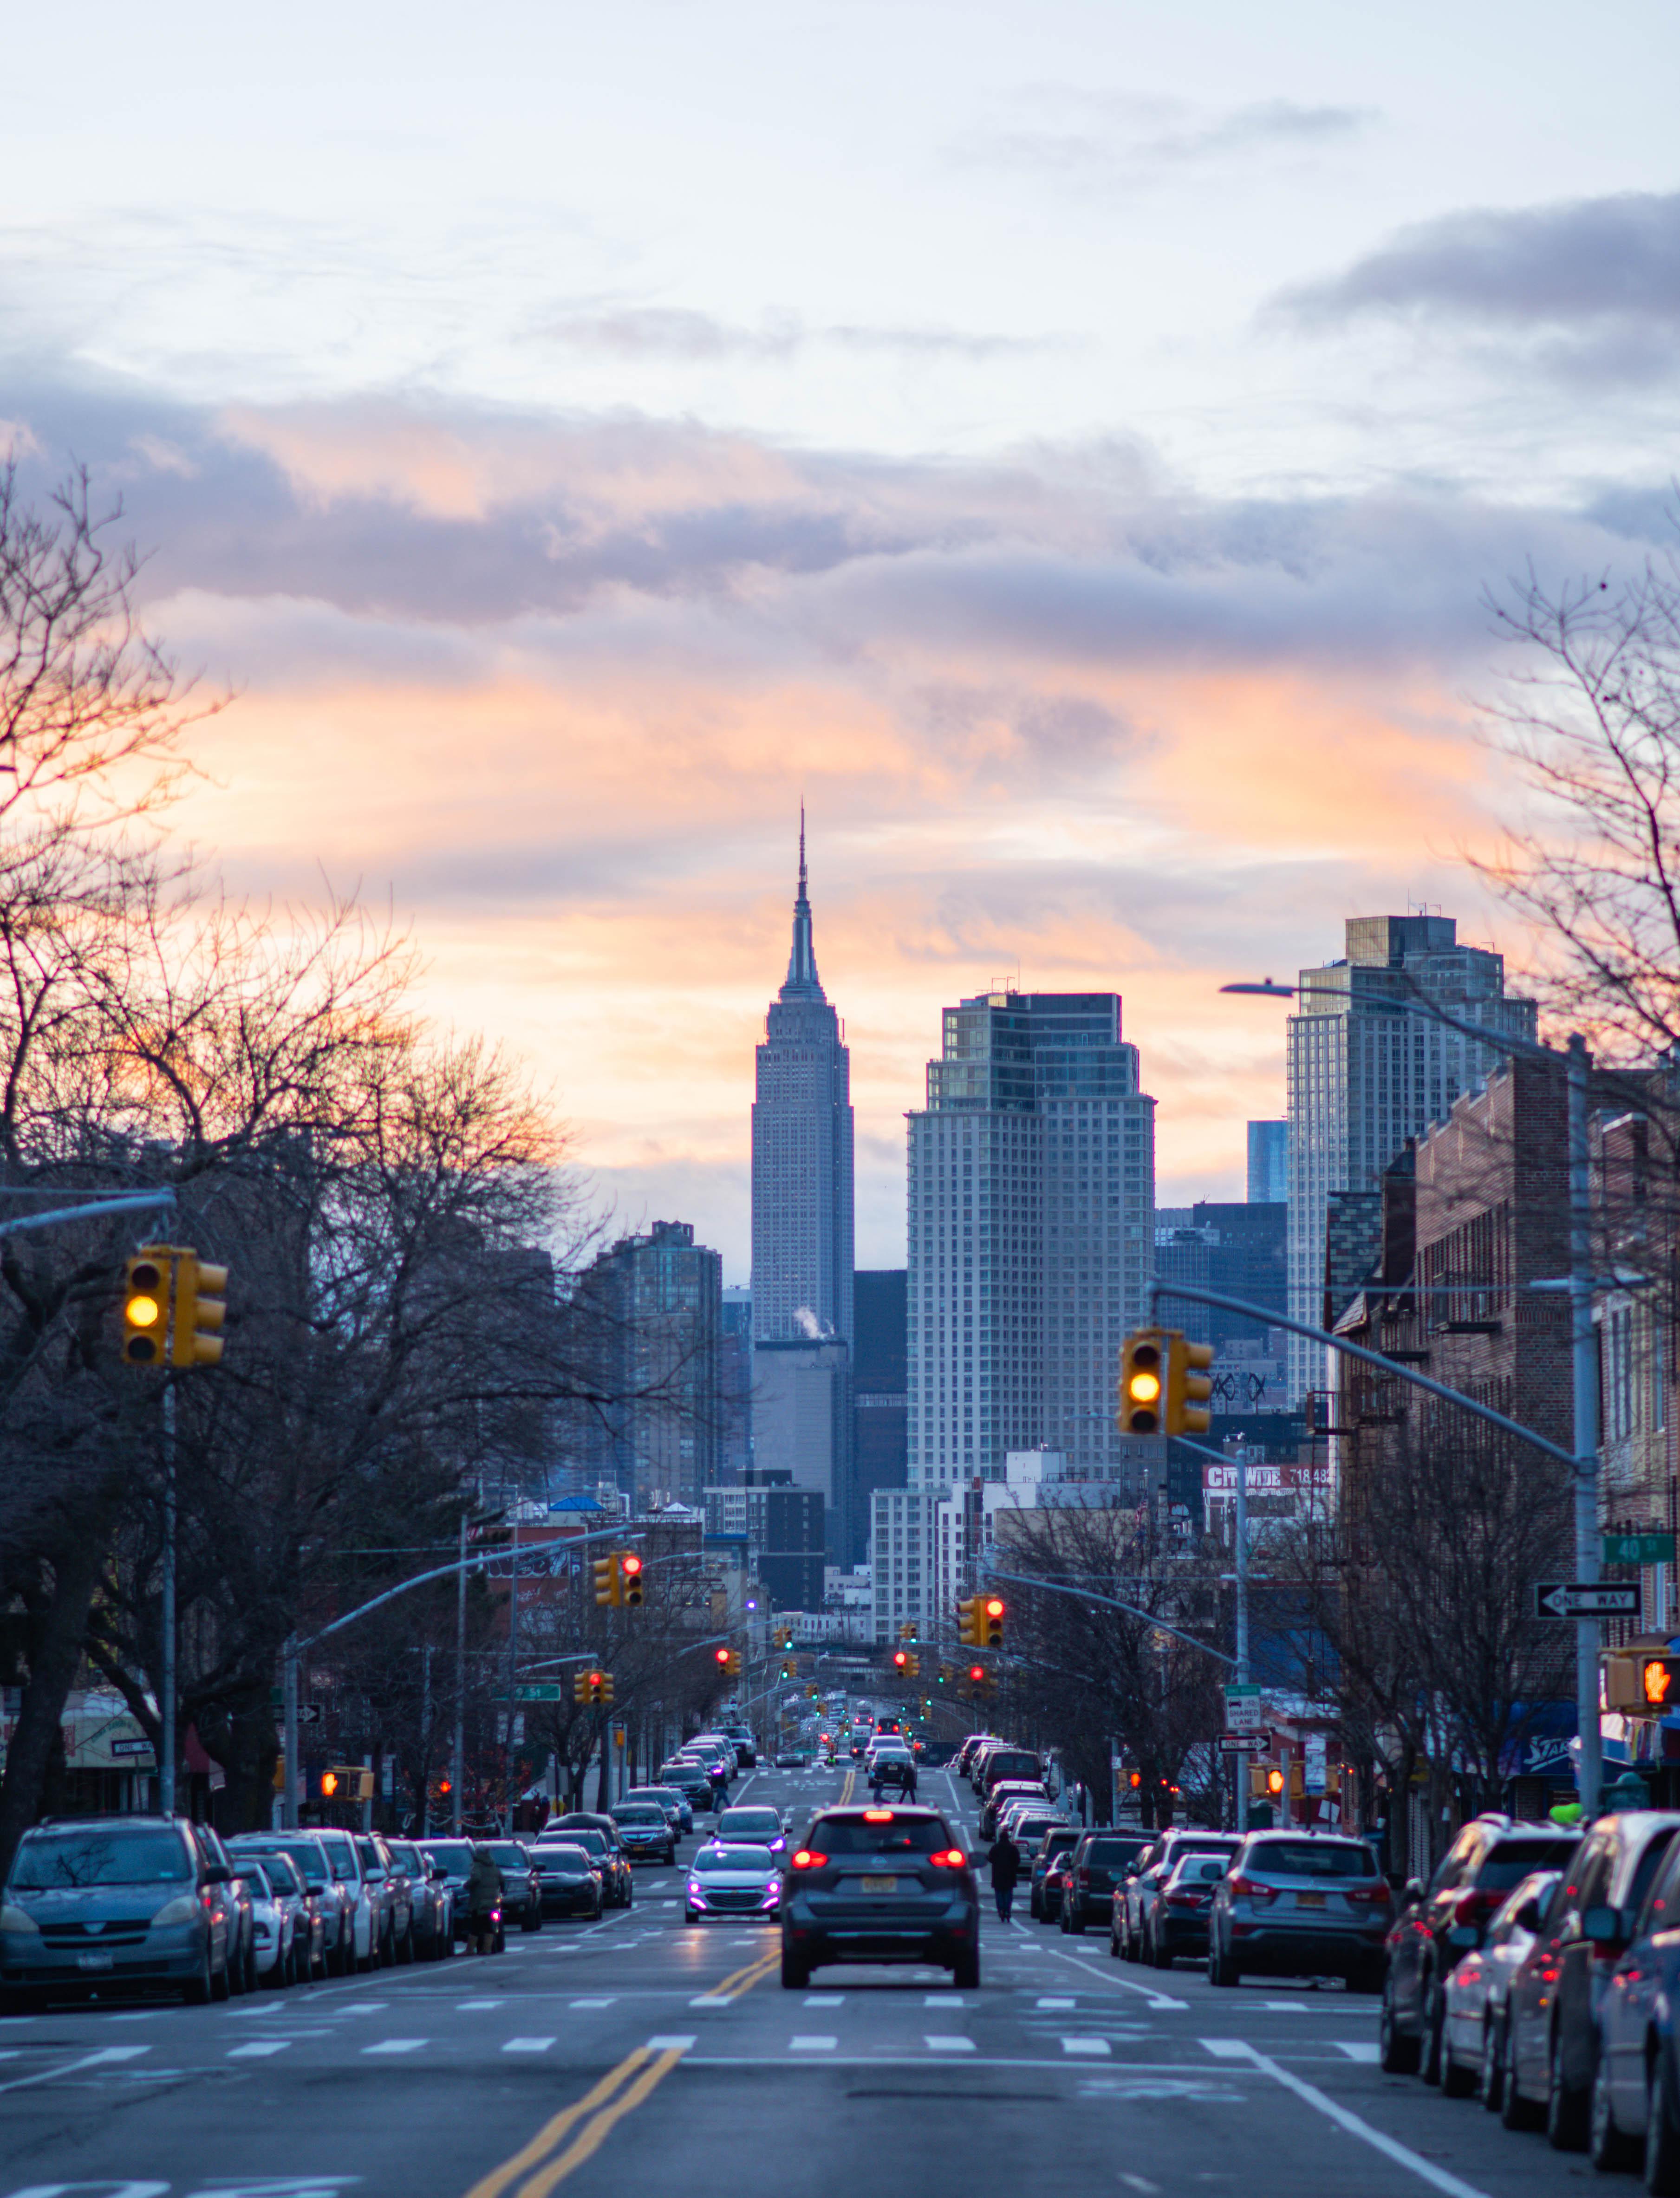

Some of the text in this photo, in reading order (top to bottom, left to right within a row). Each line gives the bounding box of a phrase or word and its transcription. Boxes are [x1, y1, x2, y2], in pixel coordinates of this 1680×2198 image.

[1208, 1467, 1281, 1487] CITWIDE
[1618, 1539, 1640, 1559] 40
[1552, 1594, 1628, 1607] ONE WAY
